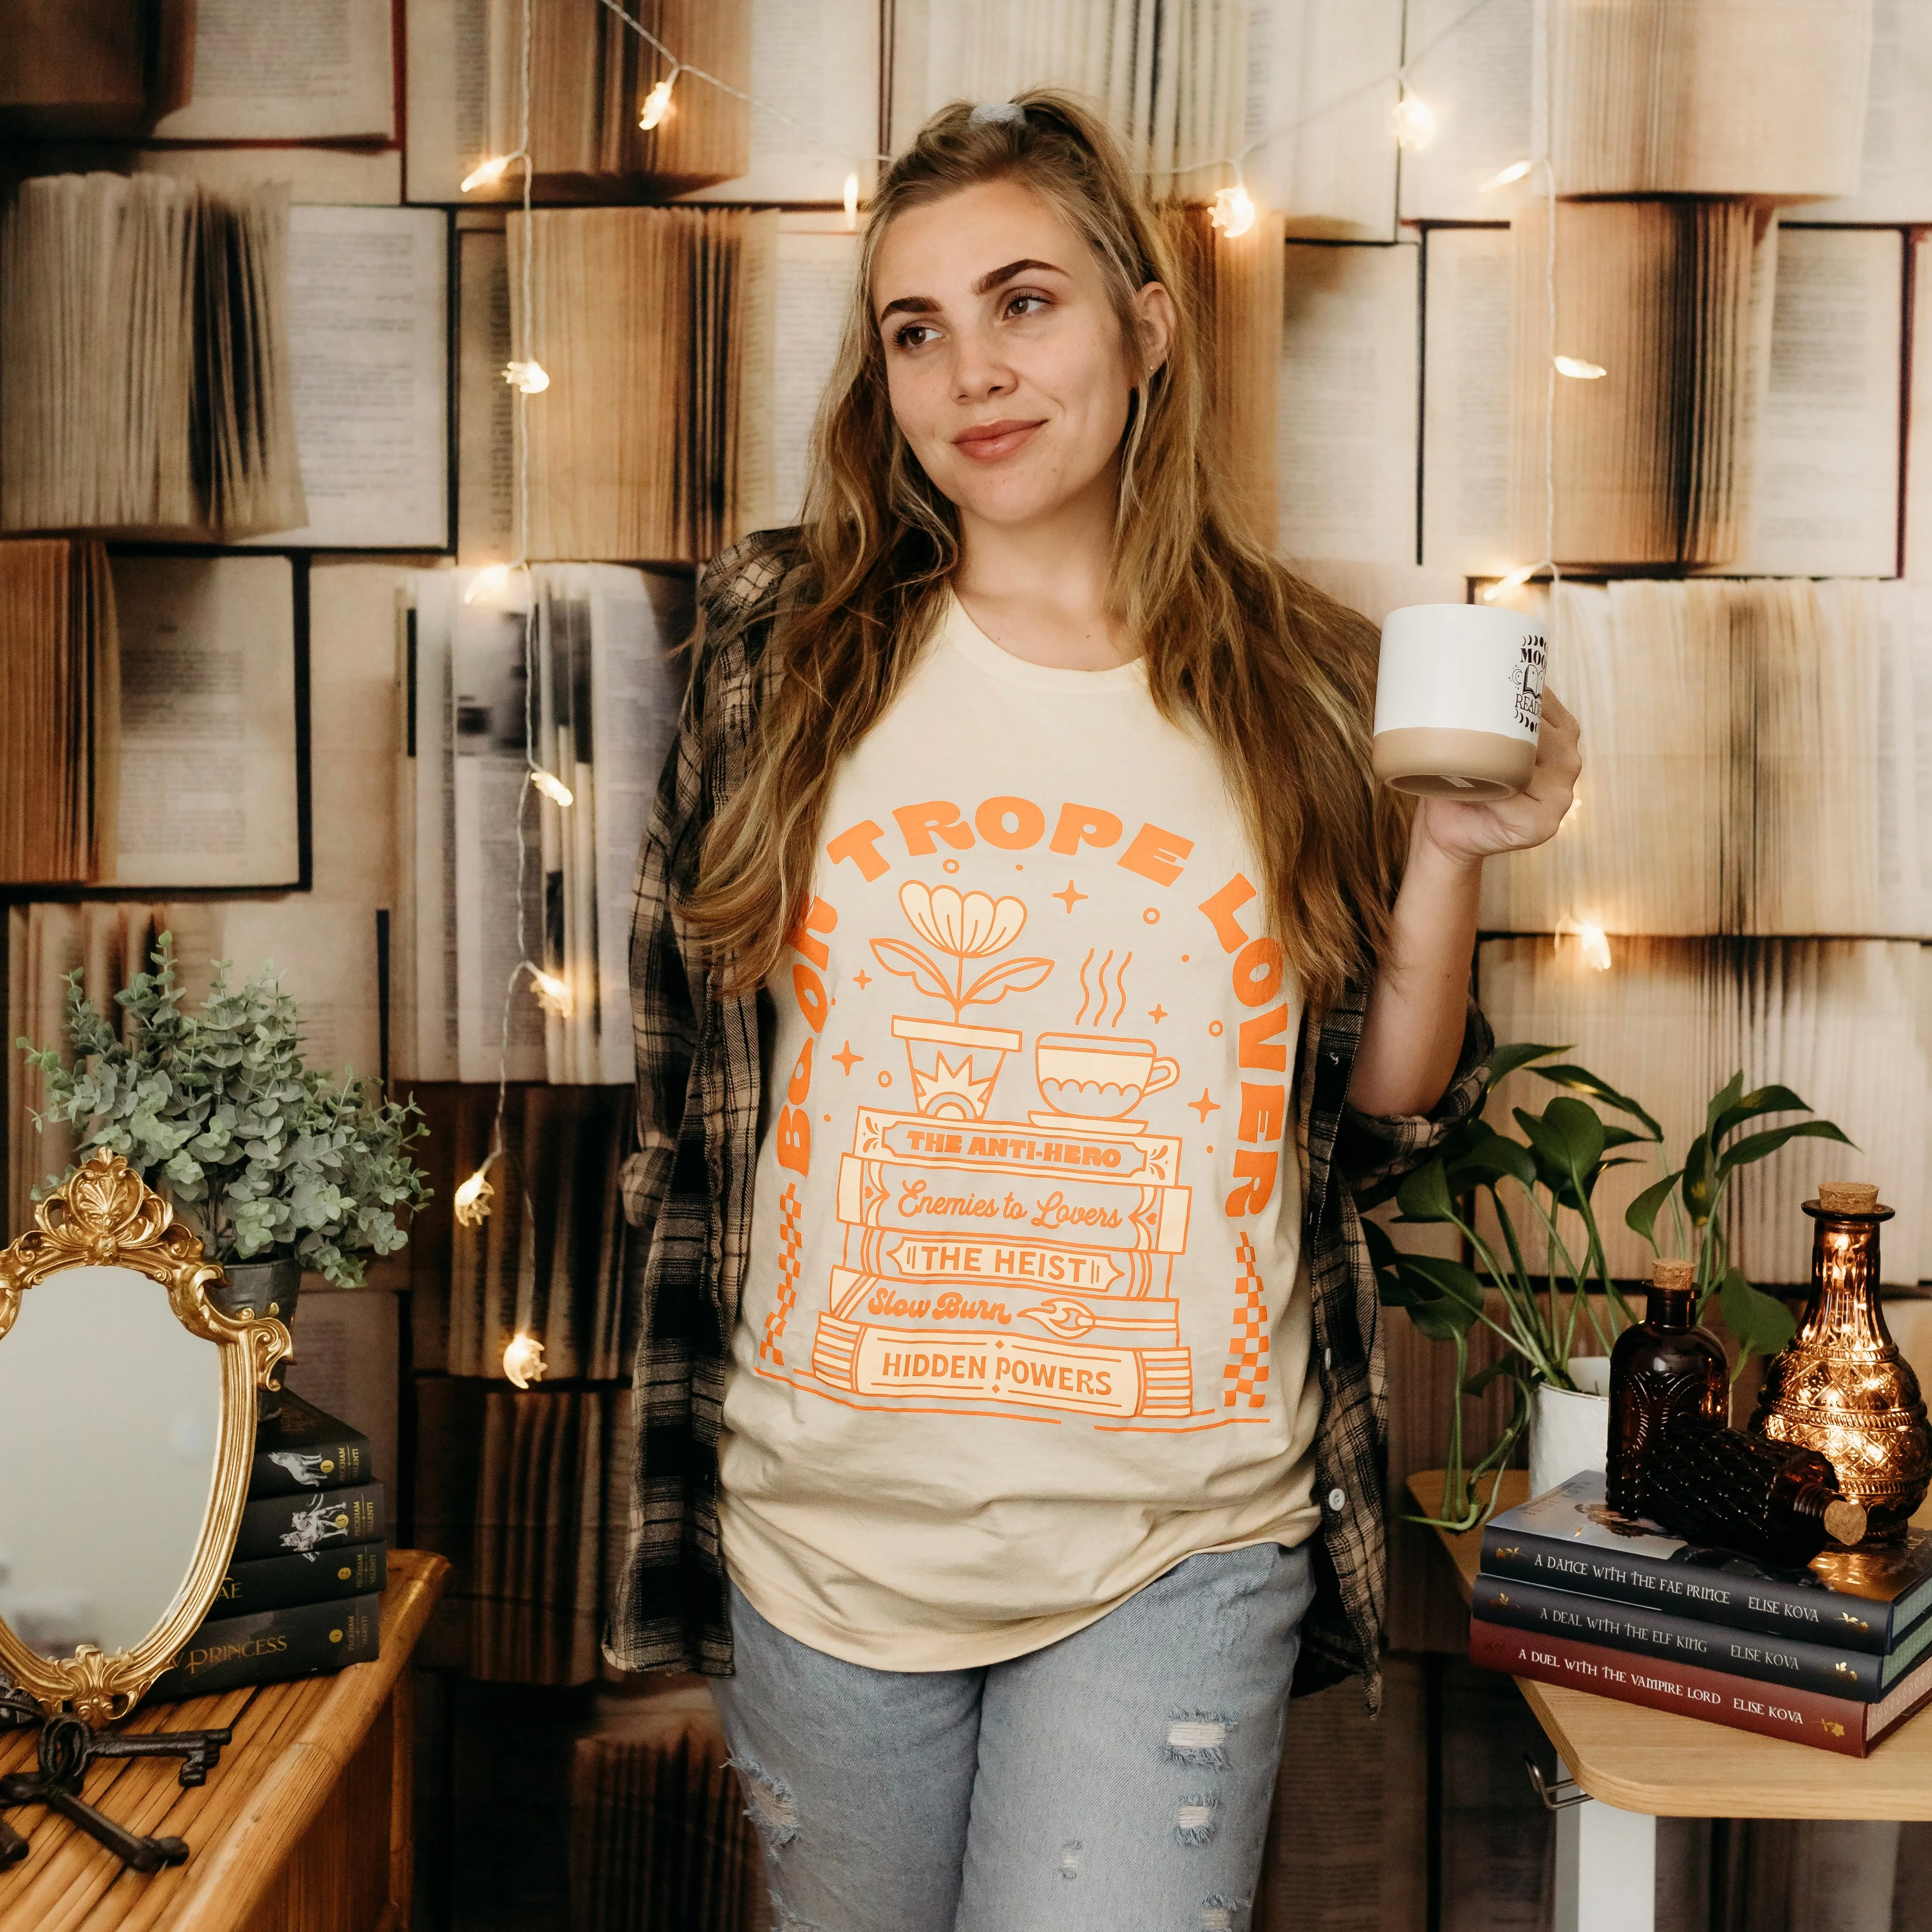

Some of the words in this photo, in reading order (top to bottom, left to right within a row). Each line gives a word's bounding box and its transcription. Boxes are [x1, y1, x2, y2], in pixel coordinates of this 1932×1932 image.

[1520, 648, 1548, 670] MOO
[826, 796, 1194, 887] TROPE
[1198, 872, 1289, 1218] LOVER
[907, 1130, 963, 1154] THE
[967, 1137, 1121, 1168] ANTI-HERO
[898, 1179, 1000, 1218] Enemies
[1003, 1191, 1028, 1220] to
[1031, 1191, 1123, 1230] Lovers
[921, 1246, 982, 1272] THE
[994, 1249, 1086, 1283] HEIST
[868, 1287, 931, 1318] Slow
[931, 1292, 1012, 1325] Burn
[882, 1353, 987, 1379] HIDDEN
[995, 1357, 1112, 1396] POWERS
[216, 1577, 242, 1601] AE
[1534, 1554, 1543, 1566] A
[1547, 1556, 1588, 1575] DANCE
[1592, 1565, 1626, 1583] WITH
[1631, 1571, 1656, 1589] THE
[1660, 1579, 1683, 1595] FAE
[1687, 1584, 1730, 1604] PRINCE
[1748, 1596, 1780, 1615] ELISE
[1784, 1604, 1820, 1623] KOVA
[184, 1636, 287, 1674] PRINCESS
[1540, 1608, 1548, 1620] A
[1553, 1610, 1582, 1627] DEAL
[1587, 1616, 1619, 1635] WITH
[1624, 1623, 1649, 1640] THE
[1653, 1630, 1673, 1645] ELF
[1677, 1635, 1707, 1653] KING
[1730, 1644, 1762, 1662] ELISE
[1765, 1652, 1799, 1670] KOVA
[1518, 1649, 1527, 1660] A
[1531, 1650, 1560, 1668] DUEL
[1564, 1658, 1597, 1676] WITH
[1602, 1666, 1627, 1683] THE
[1631, 1674, 1683, 1696] VAMPIRE
[1687, 1687, 1721, 1705] LORD
[1733, 1697, 1765, 1715] ELISE
[1768, 1705, 1804, 1725] KOVA
